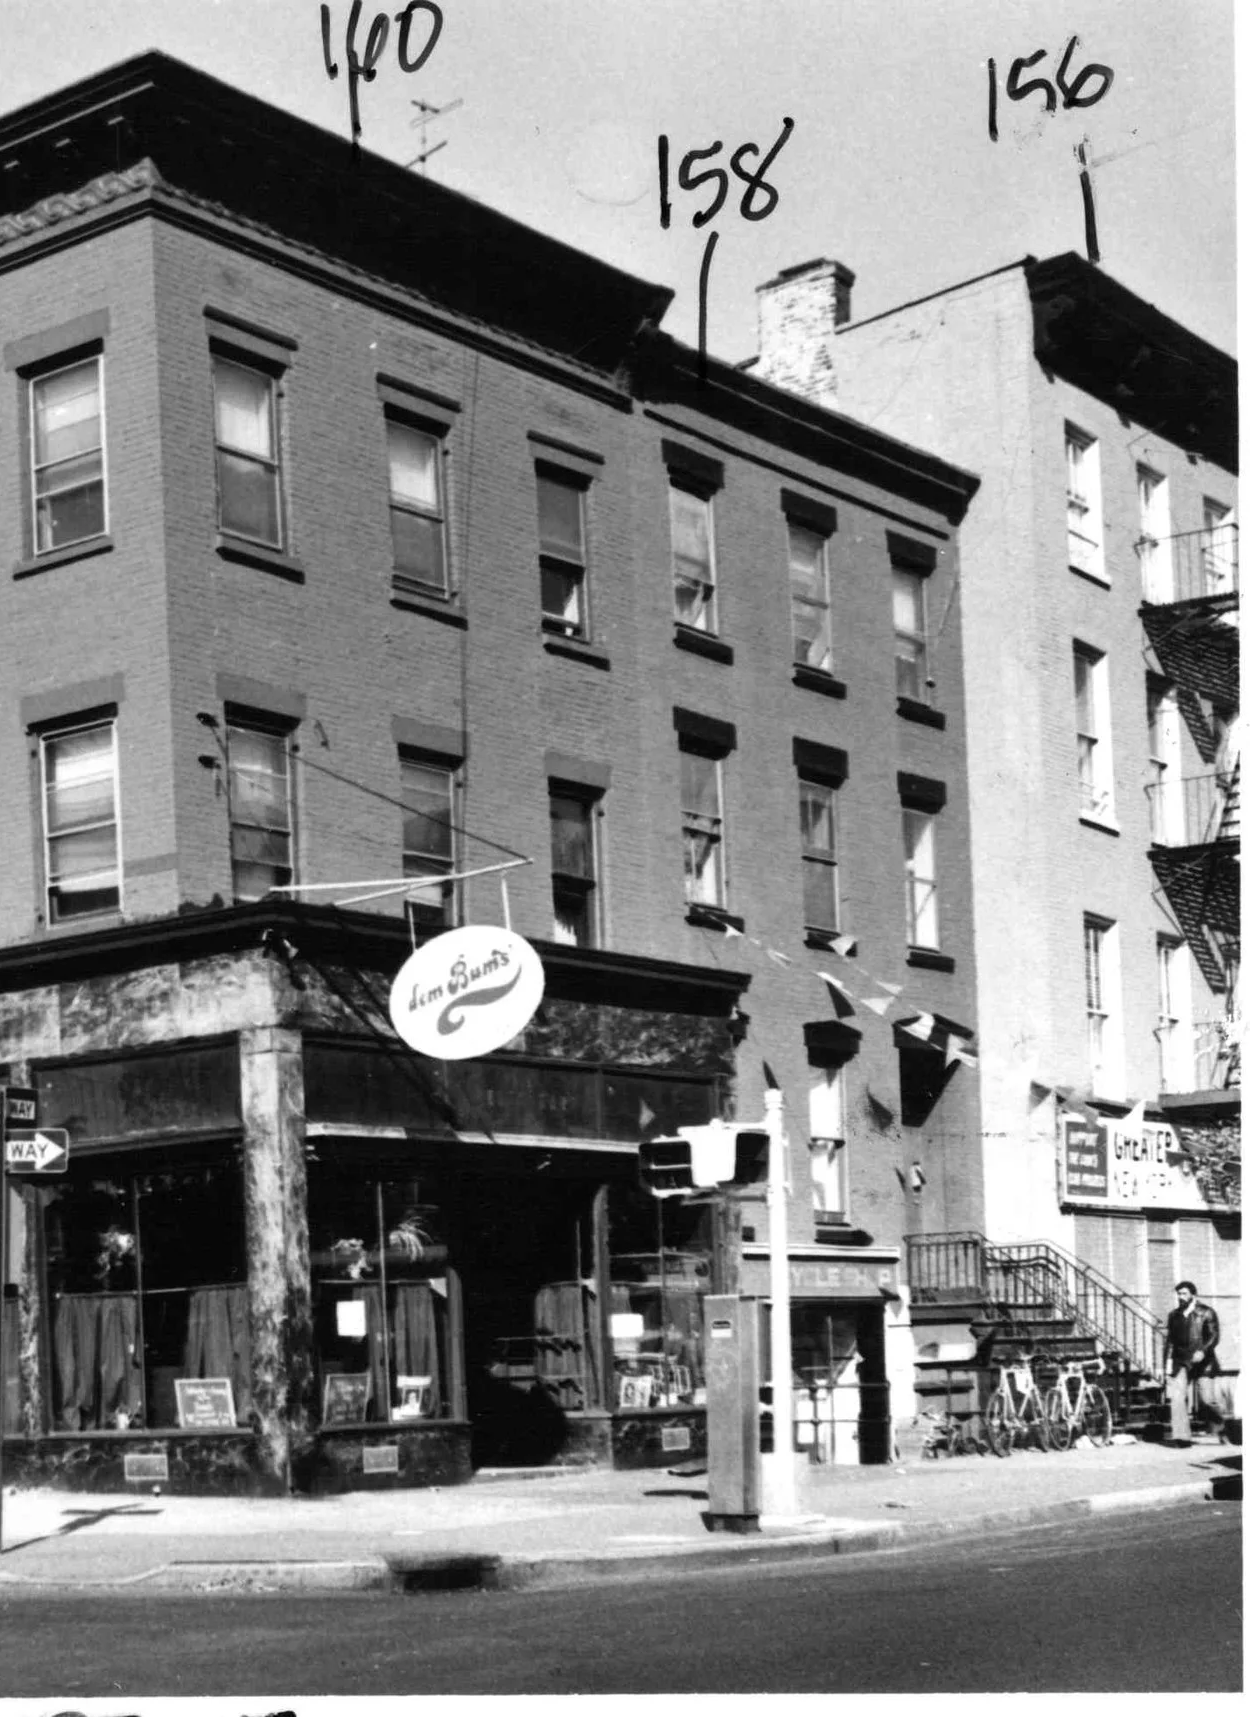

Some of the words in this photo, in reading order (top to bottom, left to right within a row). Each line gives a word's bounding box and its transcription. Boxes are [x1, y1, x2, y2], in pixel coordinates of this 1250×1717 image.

[320, 0, 444, 79] 160
[988, 36, 1114, 142] 156
[658, 117, 794, 230] 158
[9, 1100, 33, 1118] WAY
[11, 1144, 47, 1159] WAY
